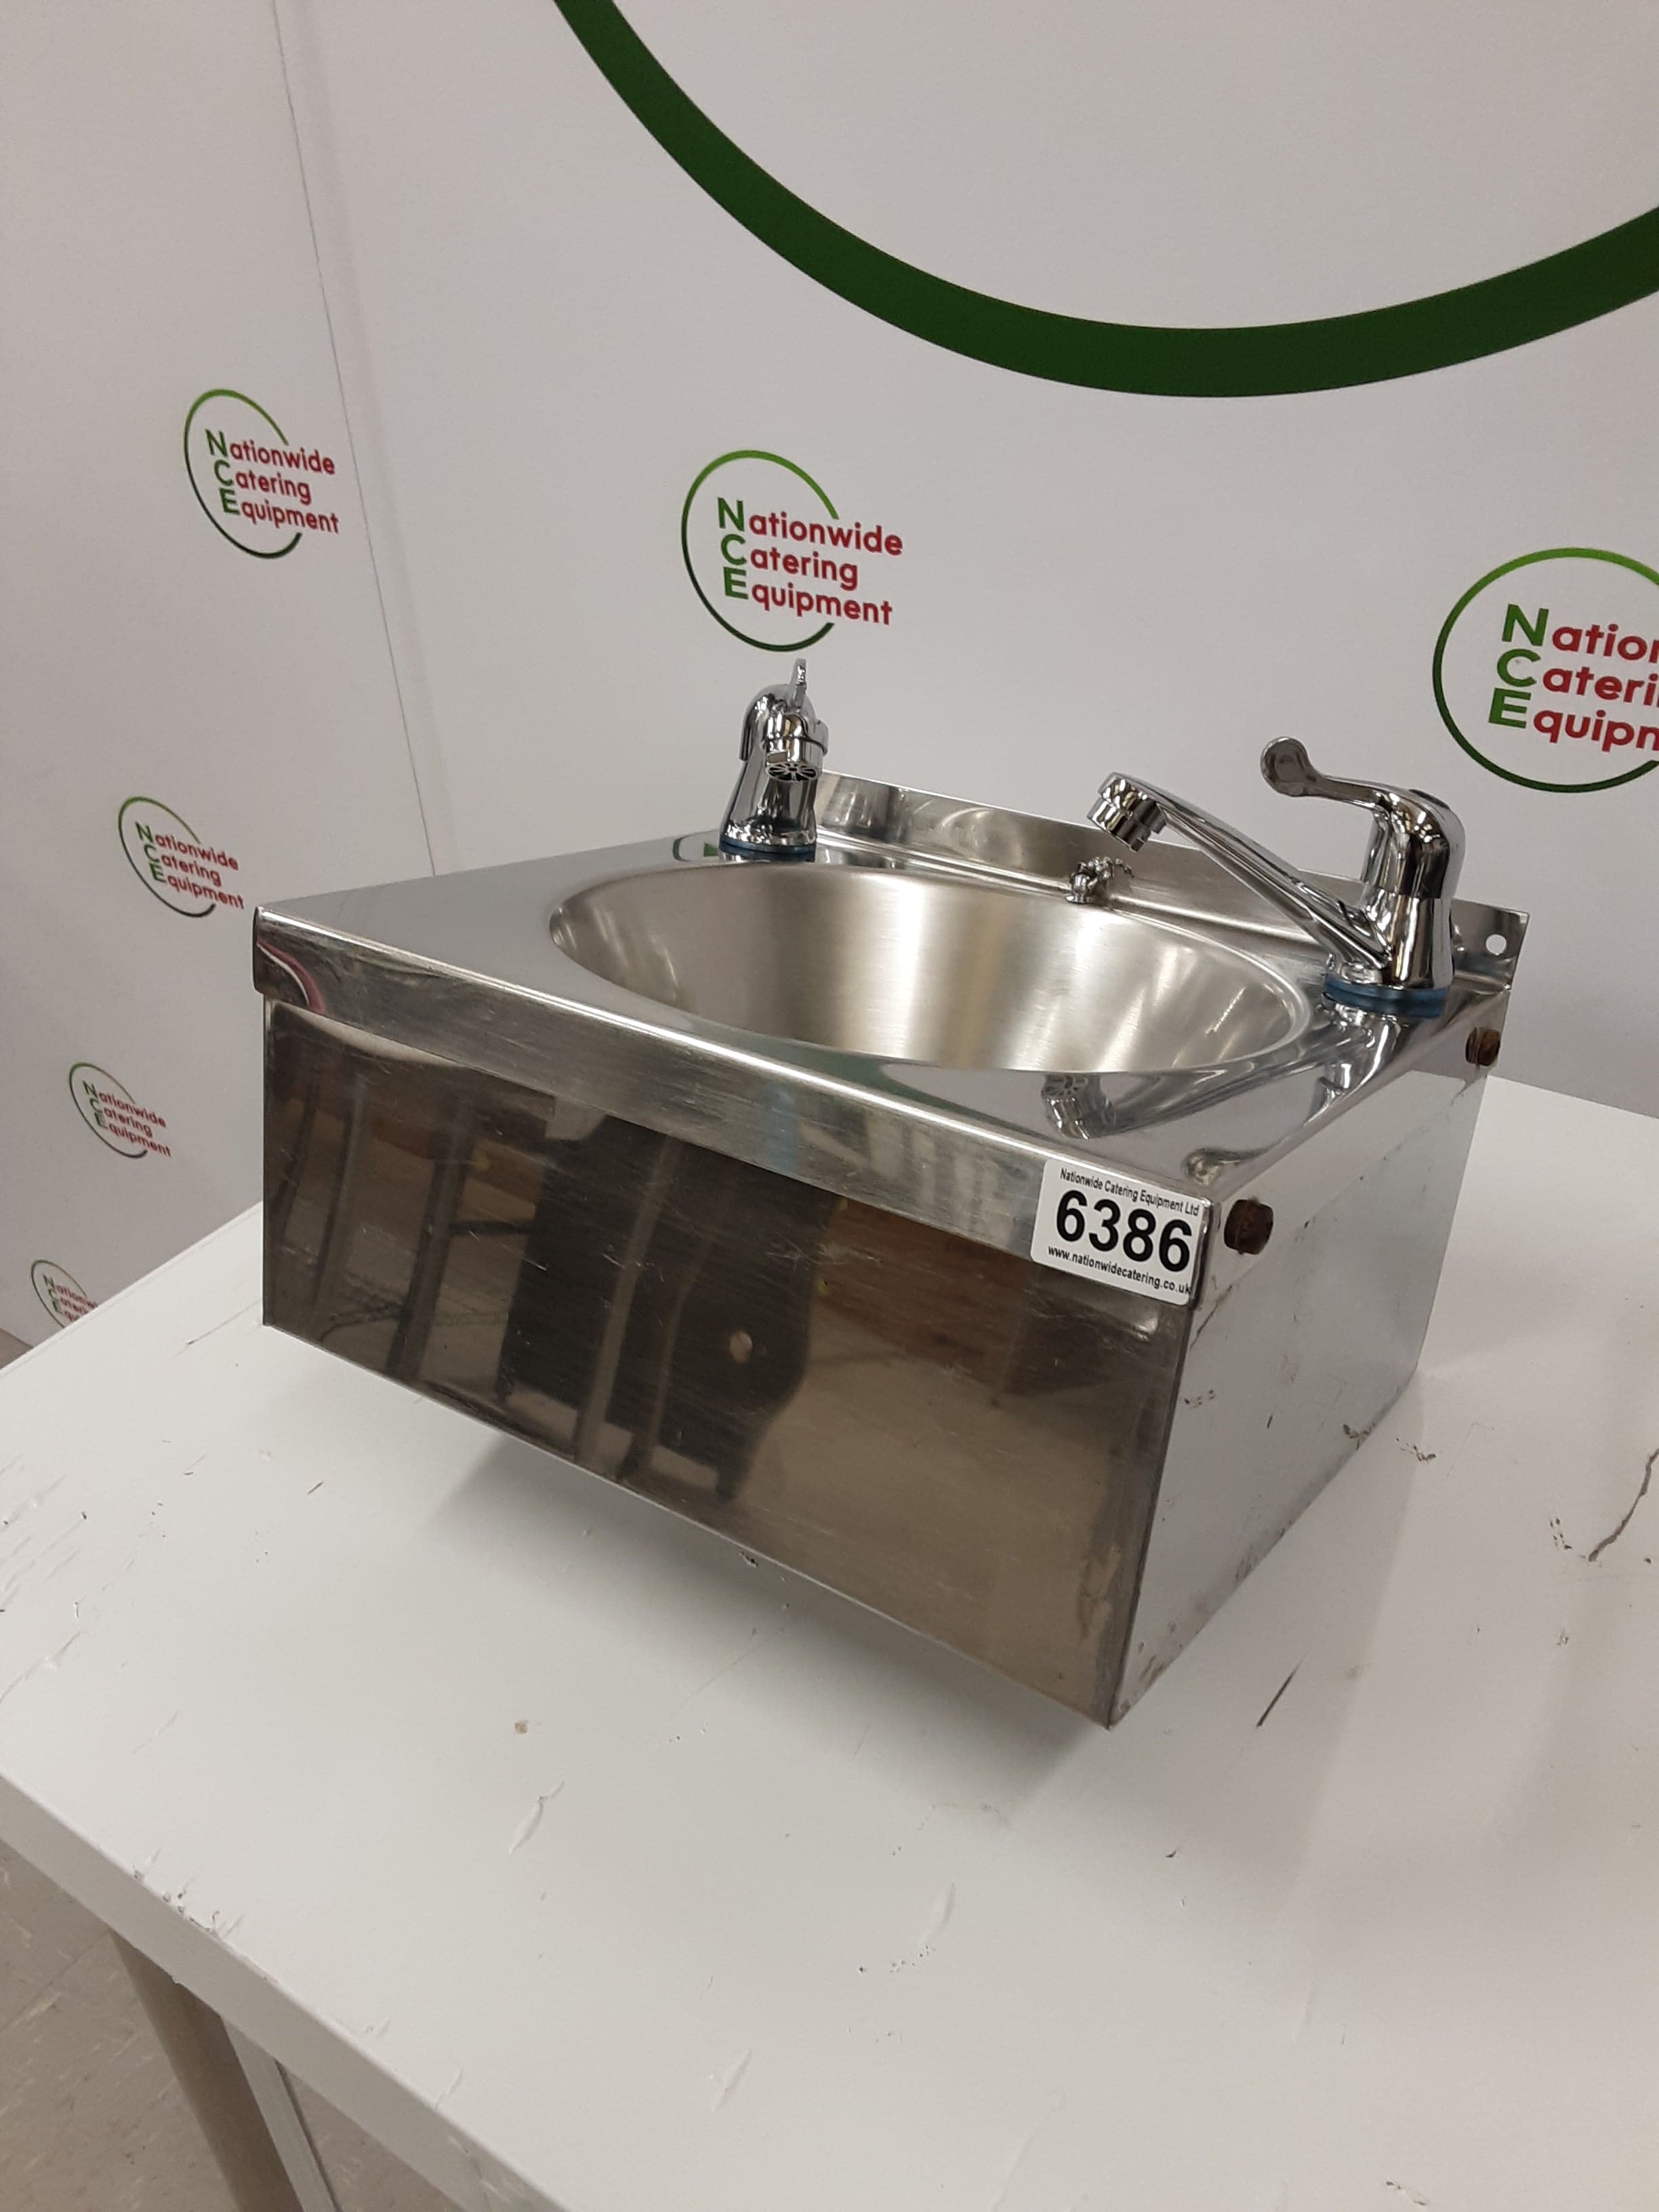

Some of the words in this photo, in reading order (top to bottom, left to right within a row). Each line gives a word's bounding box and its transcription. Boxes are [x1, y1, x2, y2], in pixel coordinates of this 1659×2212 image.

[205, 428, 335, 474] Nationwide
[214, 459, 312, 506] Catering
[219, 487, 340, 534] Equipment
[718, 497, 903, 556] Nationwide
[720, 533, 858, 591] Catering
[723, 567, 893, 626] Equipment
[136, 821, 239, 870] Nationwide
[144, 844, 222, 887] Catering
[149, 863, 244, 909] Equipment
[1060, 1168, 1103, 1190] Nationwide
[1104, 1180, 1139, 1203] Catering
[1139, 1189, 1184, 1213] Equipment
[1184, 1204, 1200, 1216] Ltd
[1056, 1189, 1193, 1273] 6386
[1047, 1245, 1191, 1295] www.nationwidecatering.co.uk
